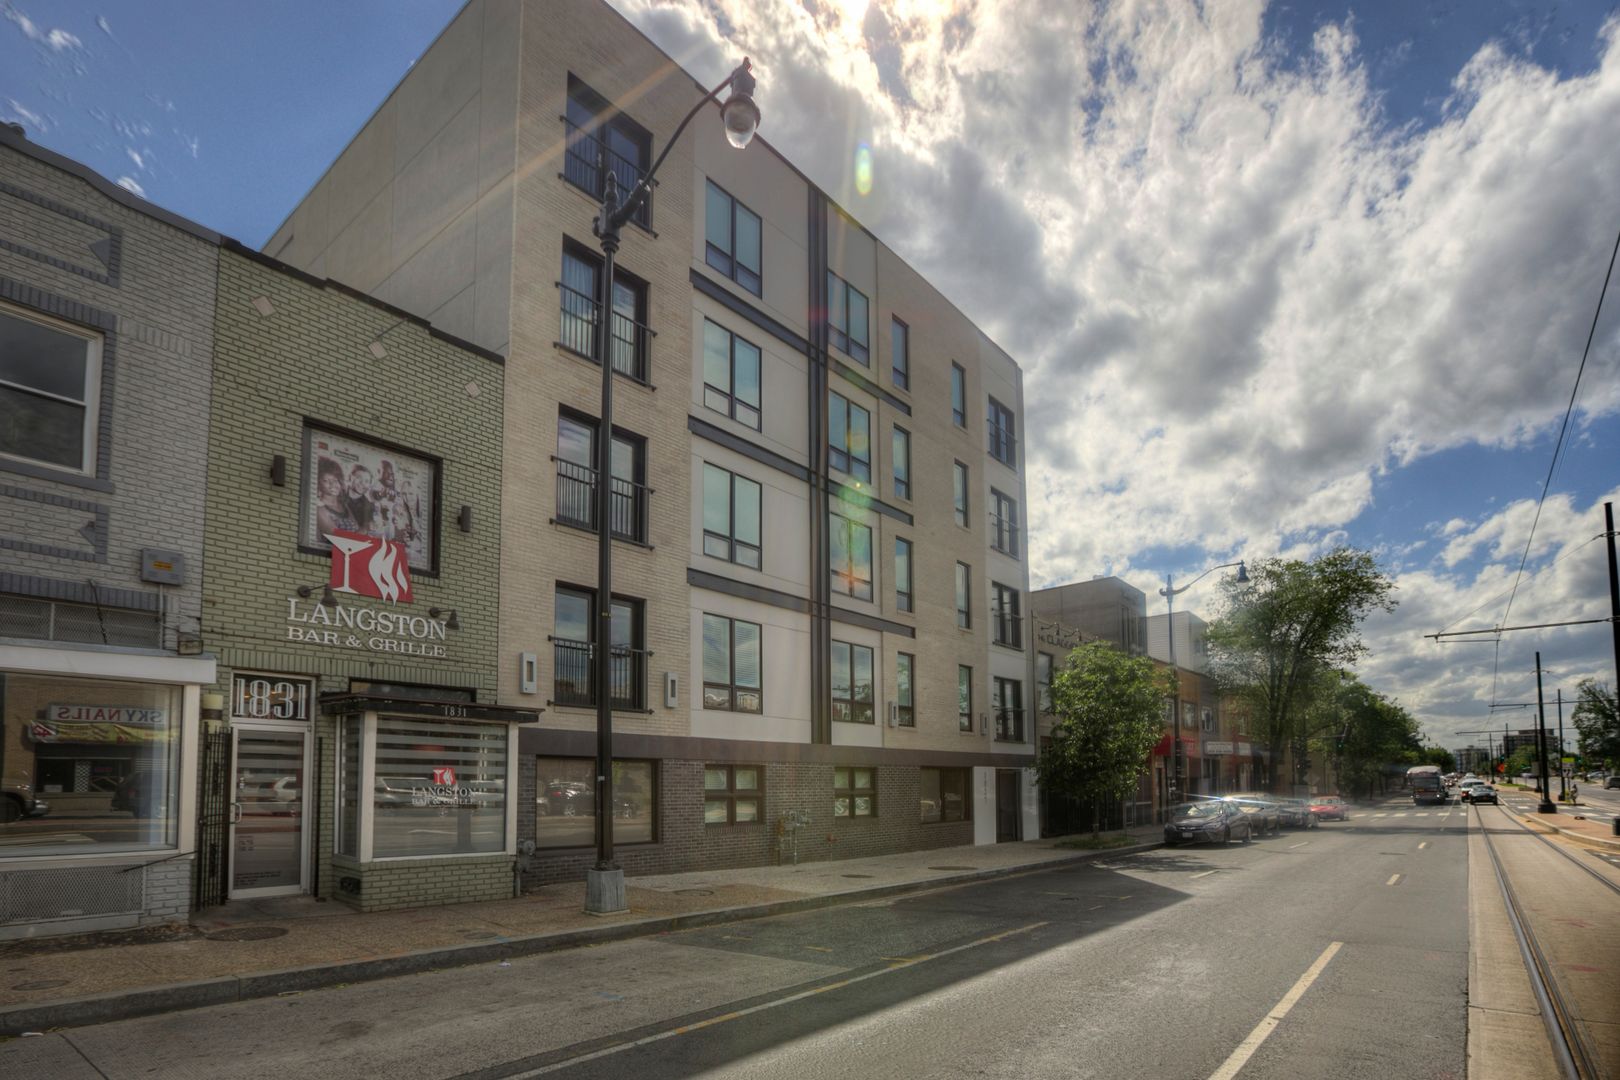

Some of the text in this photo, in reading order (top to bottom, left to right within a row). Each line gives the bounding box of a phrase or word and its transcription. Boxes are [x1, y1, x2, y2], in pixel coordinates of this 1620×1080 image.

[287, 597, 447, 640] LANGSTON
[286, 626, 447, 657] BAR & GRILLE
[234, 678, 307, 719] 1831
[444, 705, 467, 717] 1831
[412, 786, 475, 797] LANGSTON
